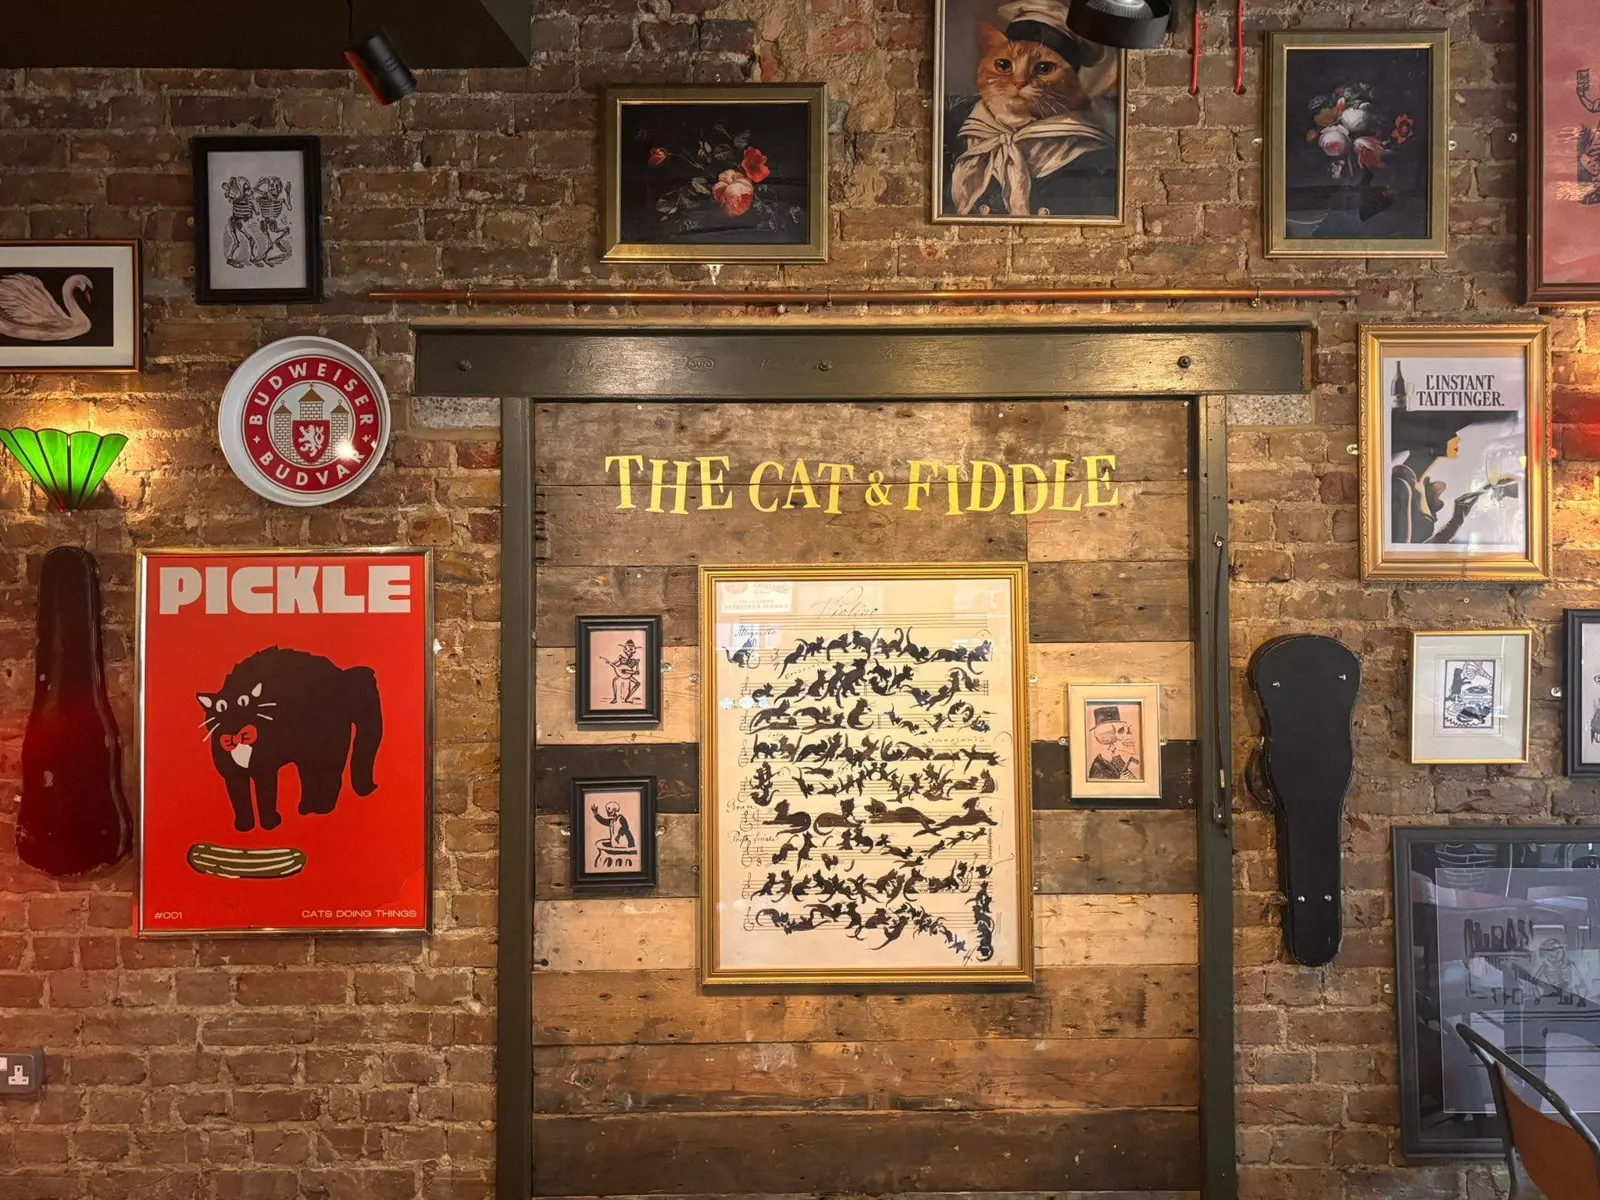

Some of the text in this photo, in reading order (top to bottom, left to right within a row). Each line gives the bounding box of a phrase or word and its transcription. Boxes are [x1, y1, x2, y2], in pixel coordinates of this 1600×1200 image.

[249, 362, 374, 426] BUDWEISER
[1425, 374, 1495, 390] L'INSTANT
[1416, 391, 1505, 407] TAITTINGER.
[259, 450, 365, 486] BUDVAR
[605, 455, 1118, 515] THE CAT & FIDDLE
[159, 565, 410, 614] PICKLE
[154, 911, 183, 920] #001
[301, 909, 417, 918] CATS DOING THINGS
